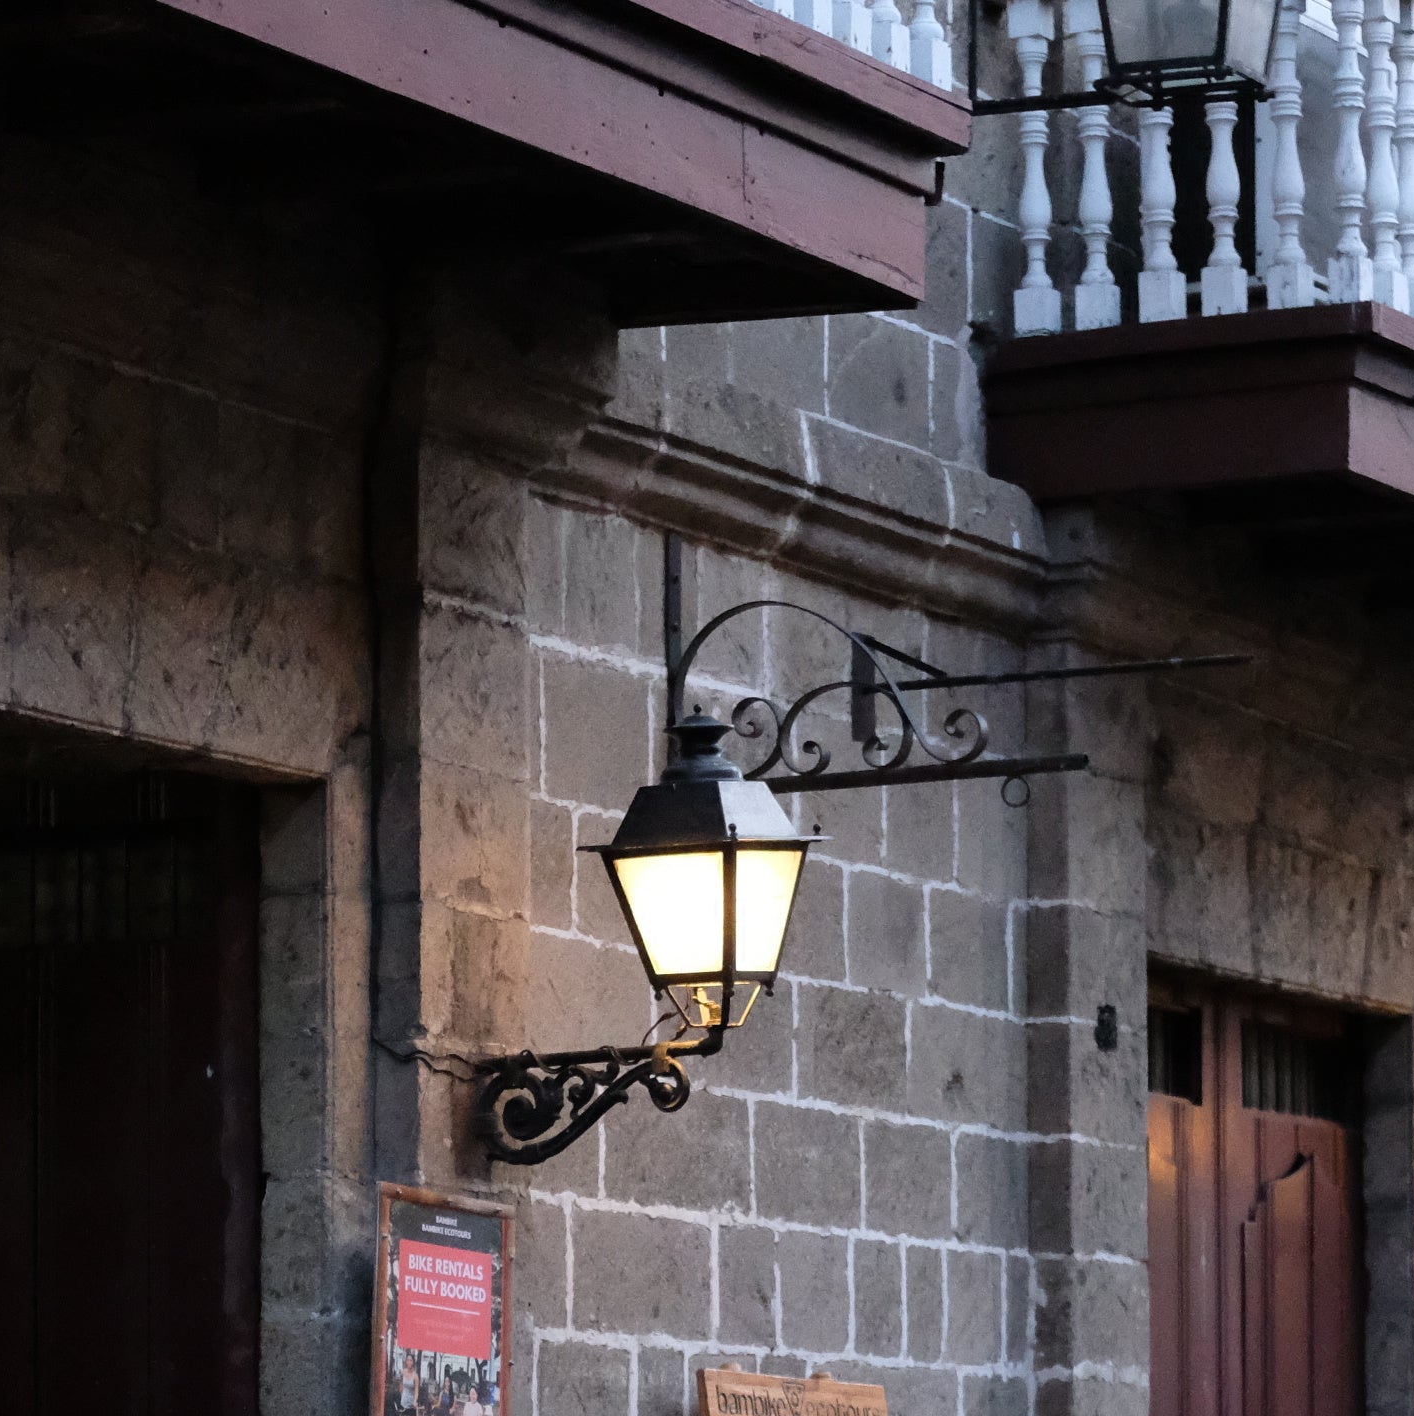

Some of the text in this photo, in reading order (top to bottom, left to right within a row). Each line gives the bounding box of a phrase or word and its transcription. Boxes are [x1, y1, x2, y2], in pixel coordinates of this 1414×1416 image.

[421, 1223, 472, 1240] BAMBIKE ECOTOURS
[408, 1253, 484, 1281] BIKE RENTALS
[404, 1275, 487, 1304] FULLY BOOKED
